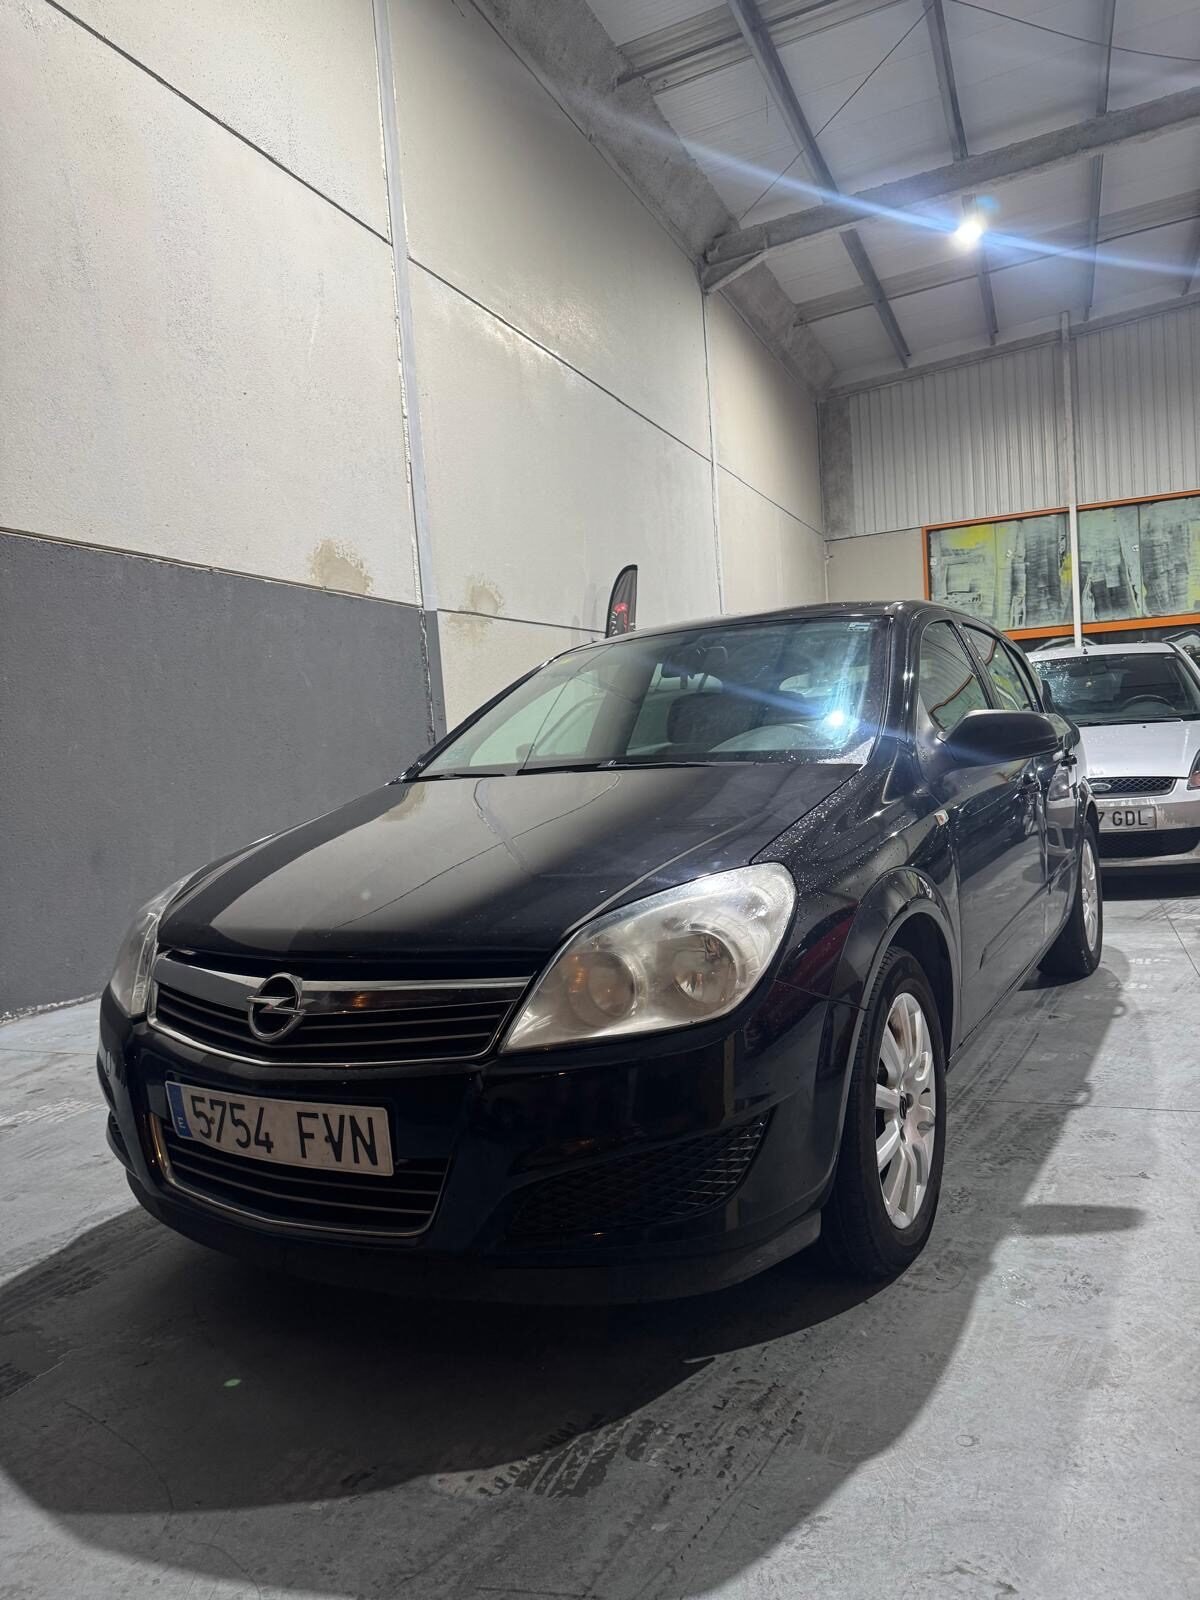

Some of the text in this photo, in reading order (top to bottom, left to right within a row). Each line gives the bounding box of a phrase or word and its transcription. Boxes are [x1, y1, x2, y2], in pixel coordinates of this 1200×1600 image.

[1112, 810, 1149, 826] GDL
[177, 1116, 187, 1129] E
[190, 1095, 378, 1166] 5754 FVN
